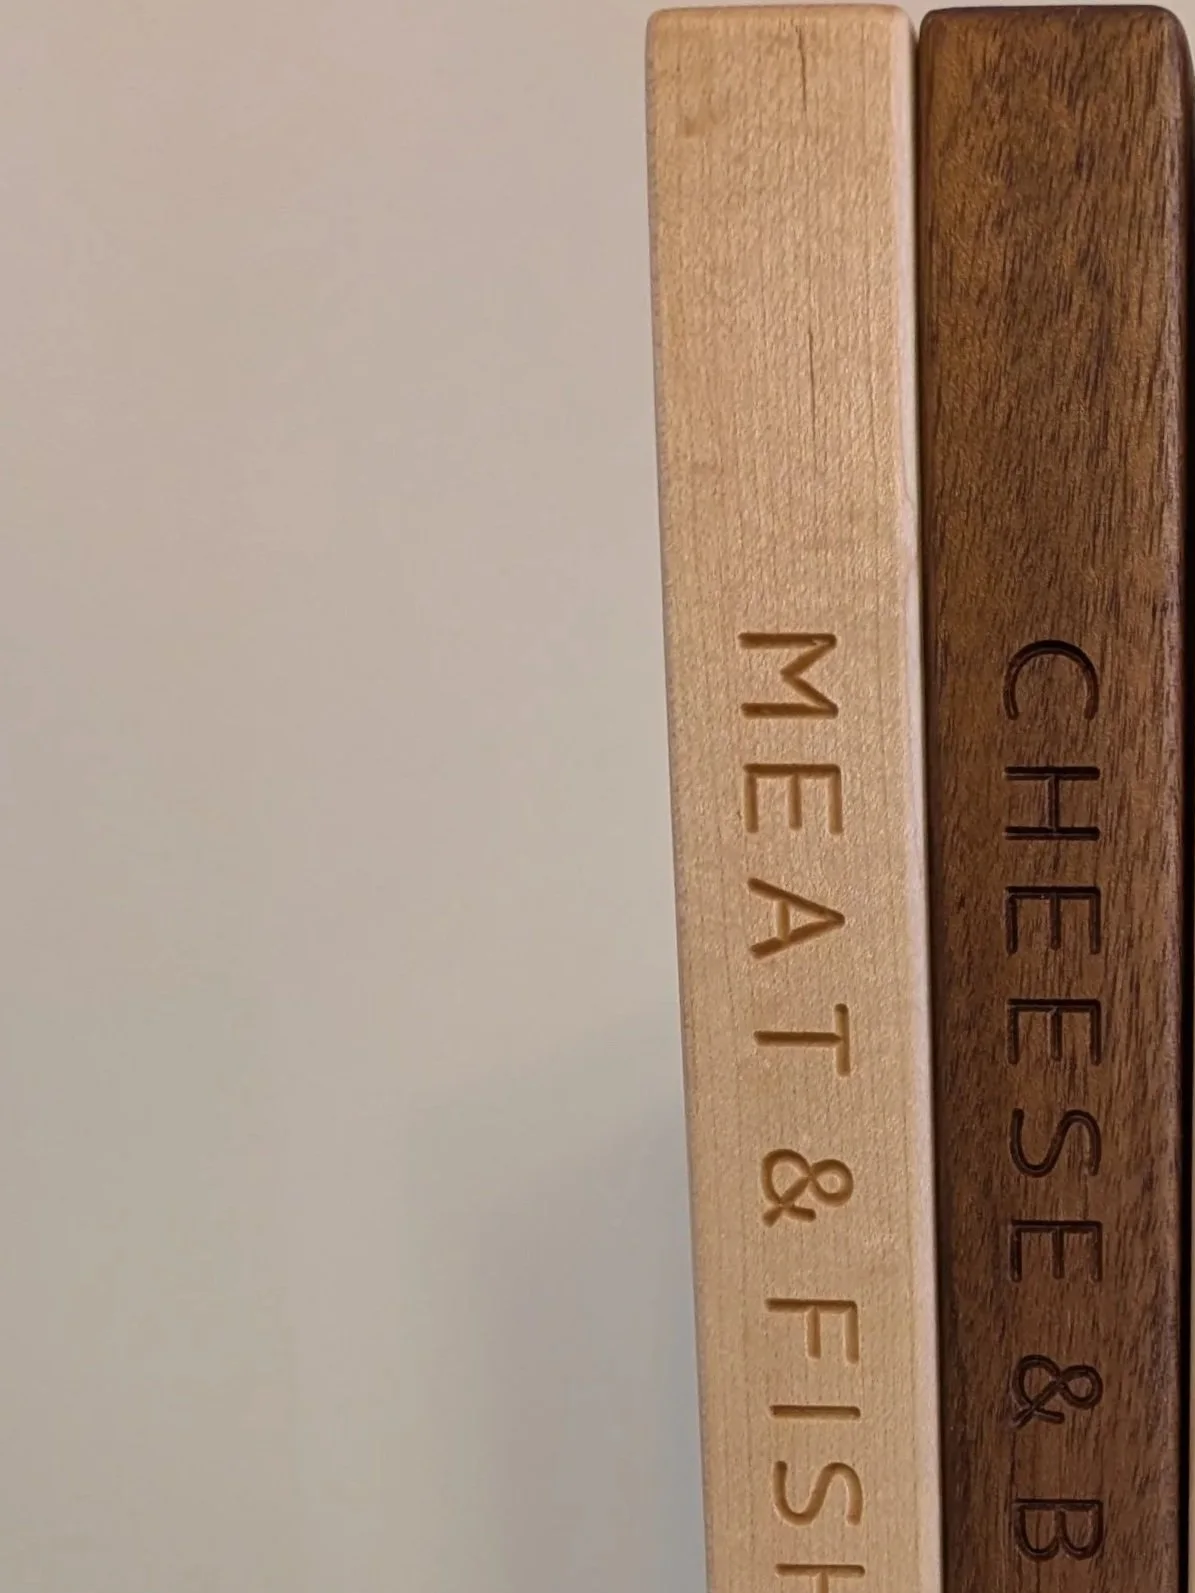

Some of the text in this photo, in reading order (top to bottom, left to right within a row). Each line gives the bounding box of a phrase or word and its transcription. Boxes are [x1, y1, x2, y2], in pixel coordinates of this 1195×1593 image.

[738, 632, 851, 1077] MEAT
[1003, 639, 1101, 1283] CHEESE
[760, 1148, 855, 1228] &
[1013, 1353, 1102, 1429] &
